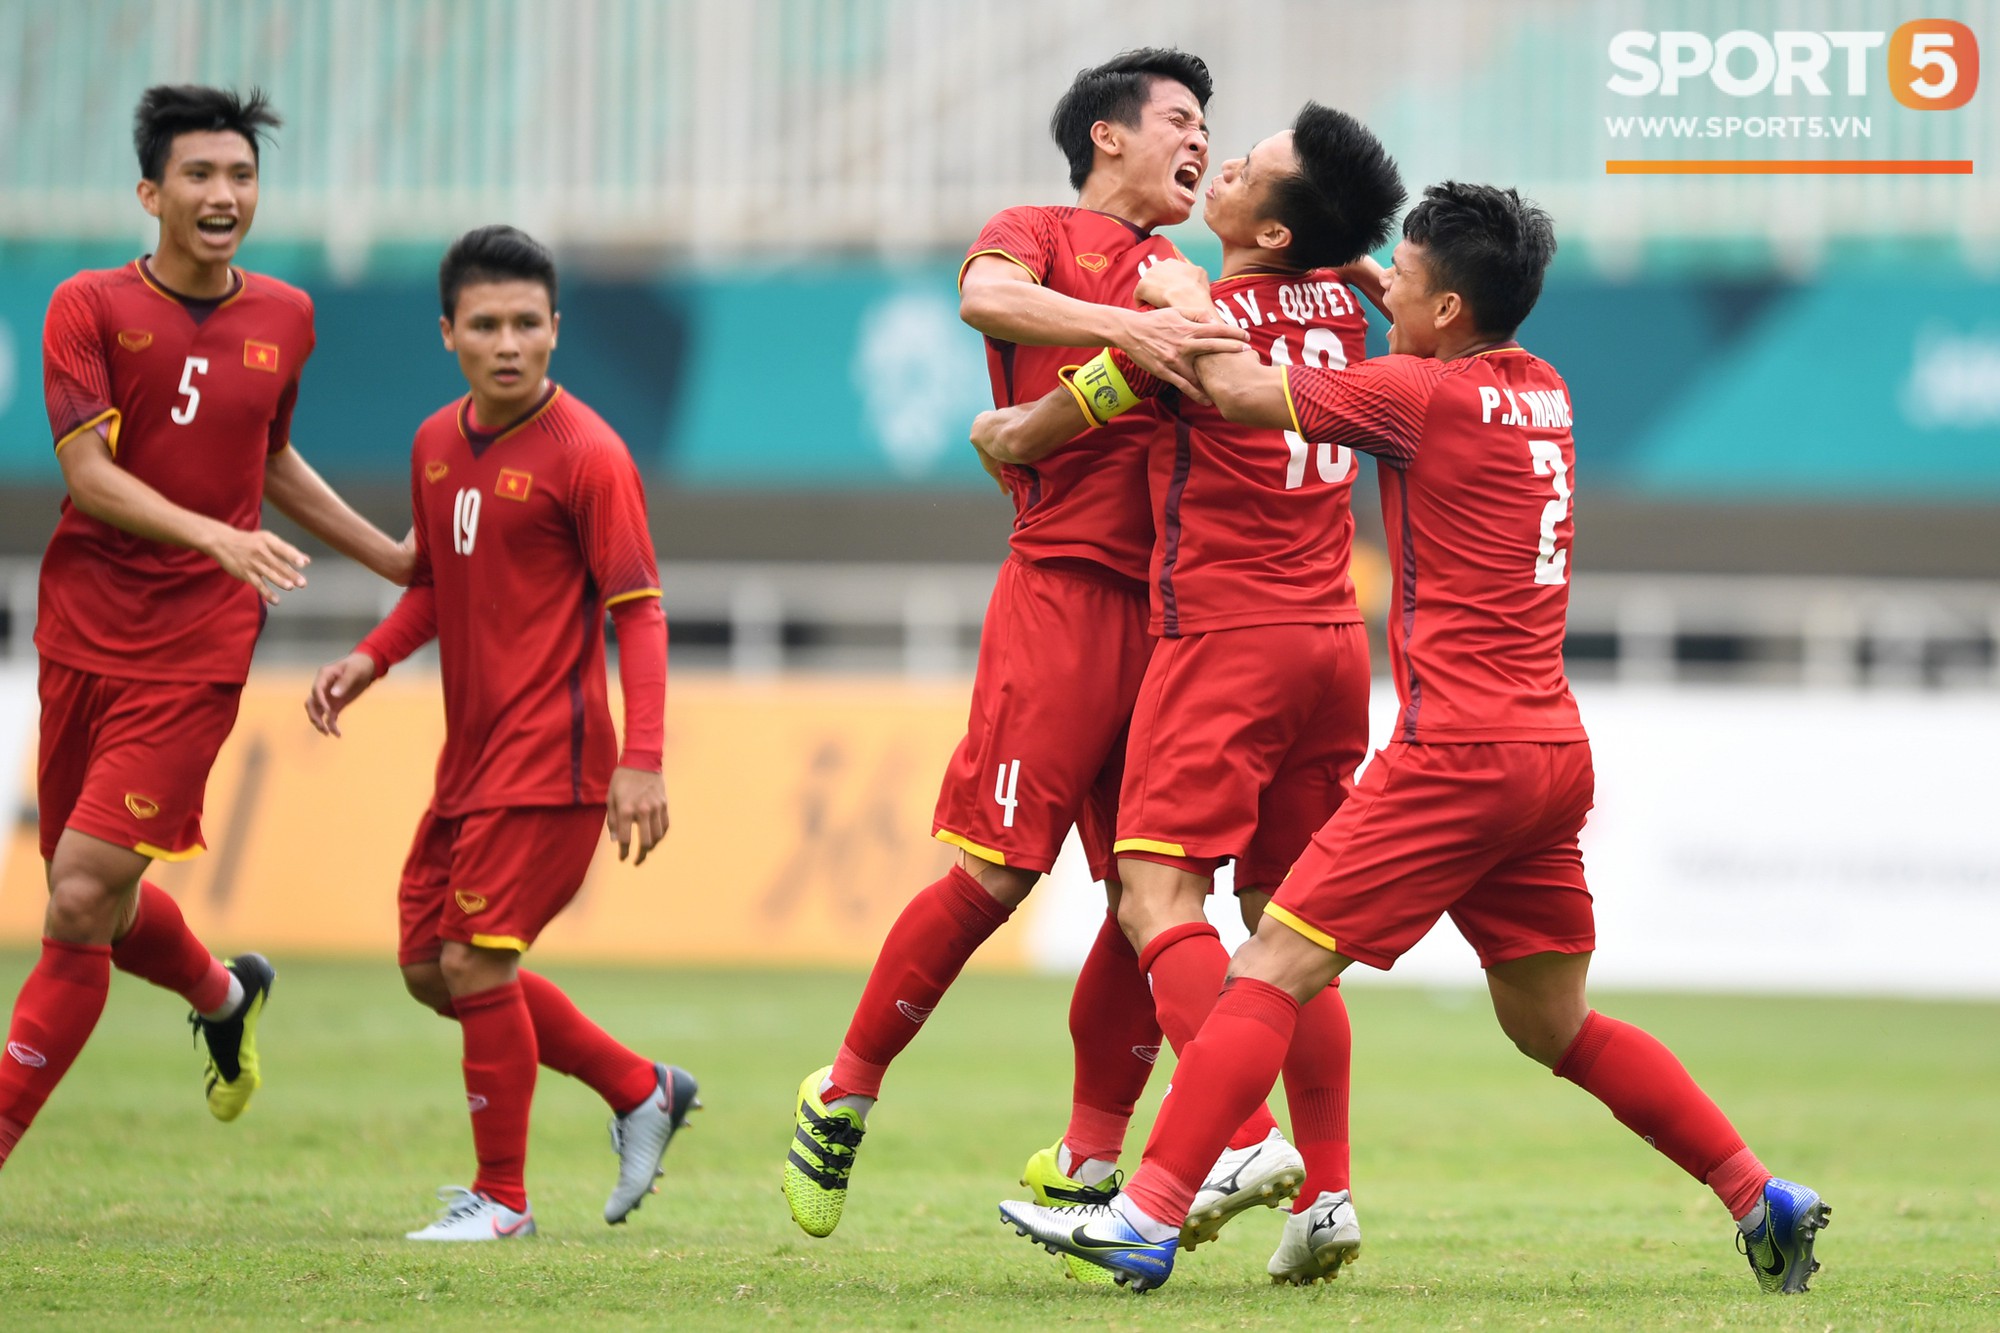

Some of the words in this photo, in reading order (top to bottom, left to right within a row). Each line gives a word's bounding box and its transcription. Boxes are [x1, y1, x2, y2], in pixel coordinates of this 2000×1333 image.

[1278, 282, 1354, 325] QUYET
[171, 355, 208, 425] 5
[453, 487, 482, 556] 19
[1528, 440, 1571, 585] 2
[995, 759, 1021, 828] 4
